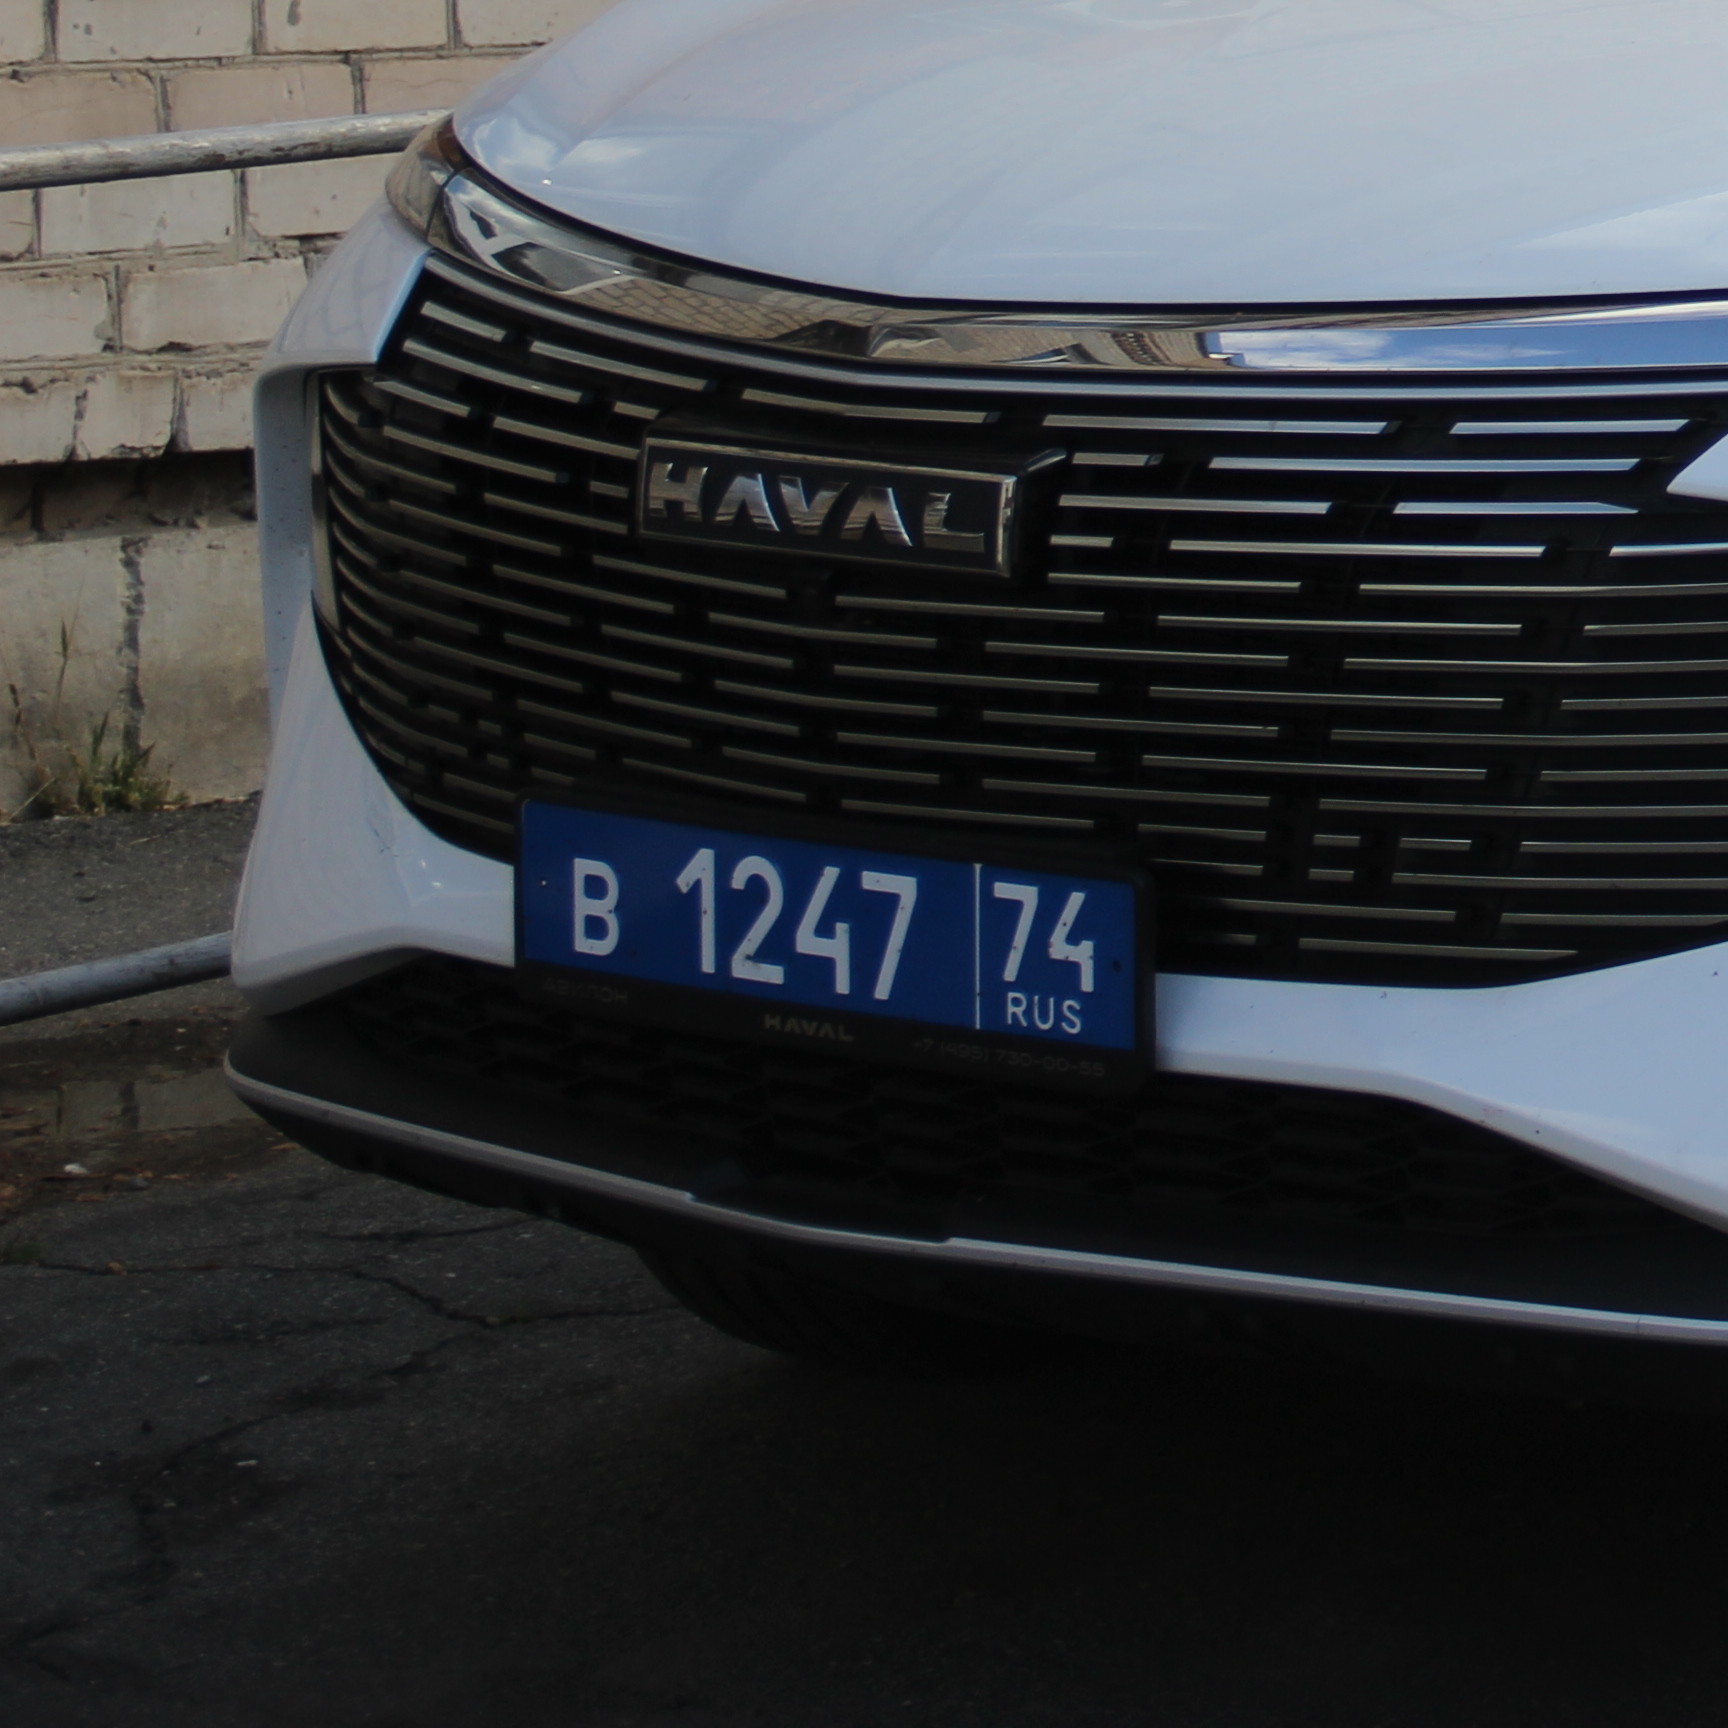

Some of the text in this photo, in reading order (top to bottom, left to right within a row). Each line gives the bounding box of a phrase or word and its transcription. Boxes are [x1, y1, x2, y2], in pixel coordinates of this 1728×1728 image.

[648, 462, 985, 554] HAVAL
[573, 847, 1095, 1001] В 1247 74
[764, 1013, 855, 1043] HAVAL
[1006, 991, 1083, 1035] RUS
